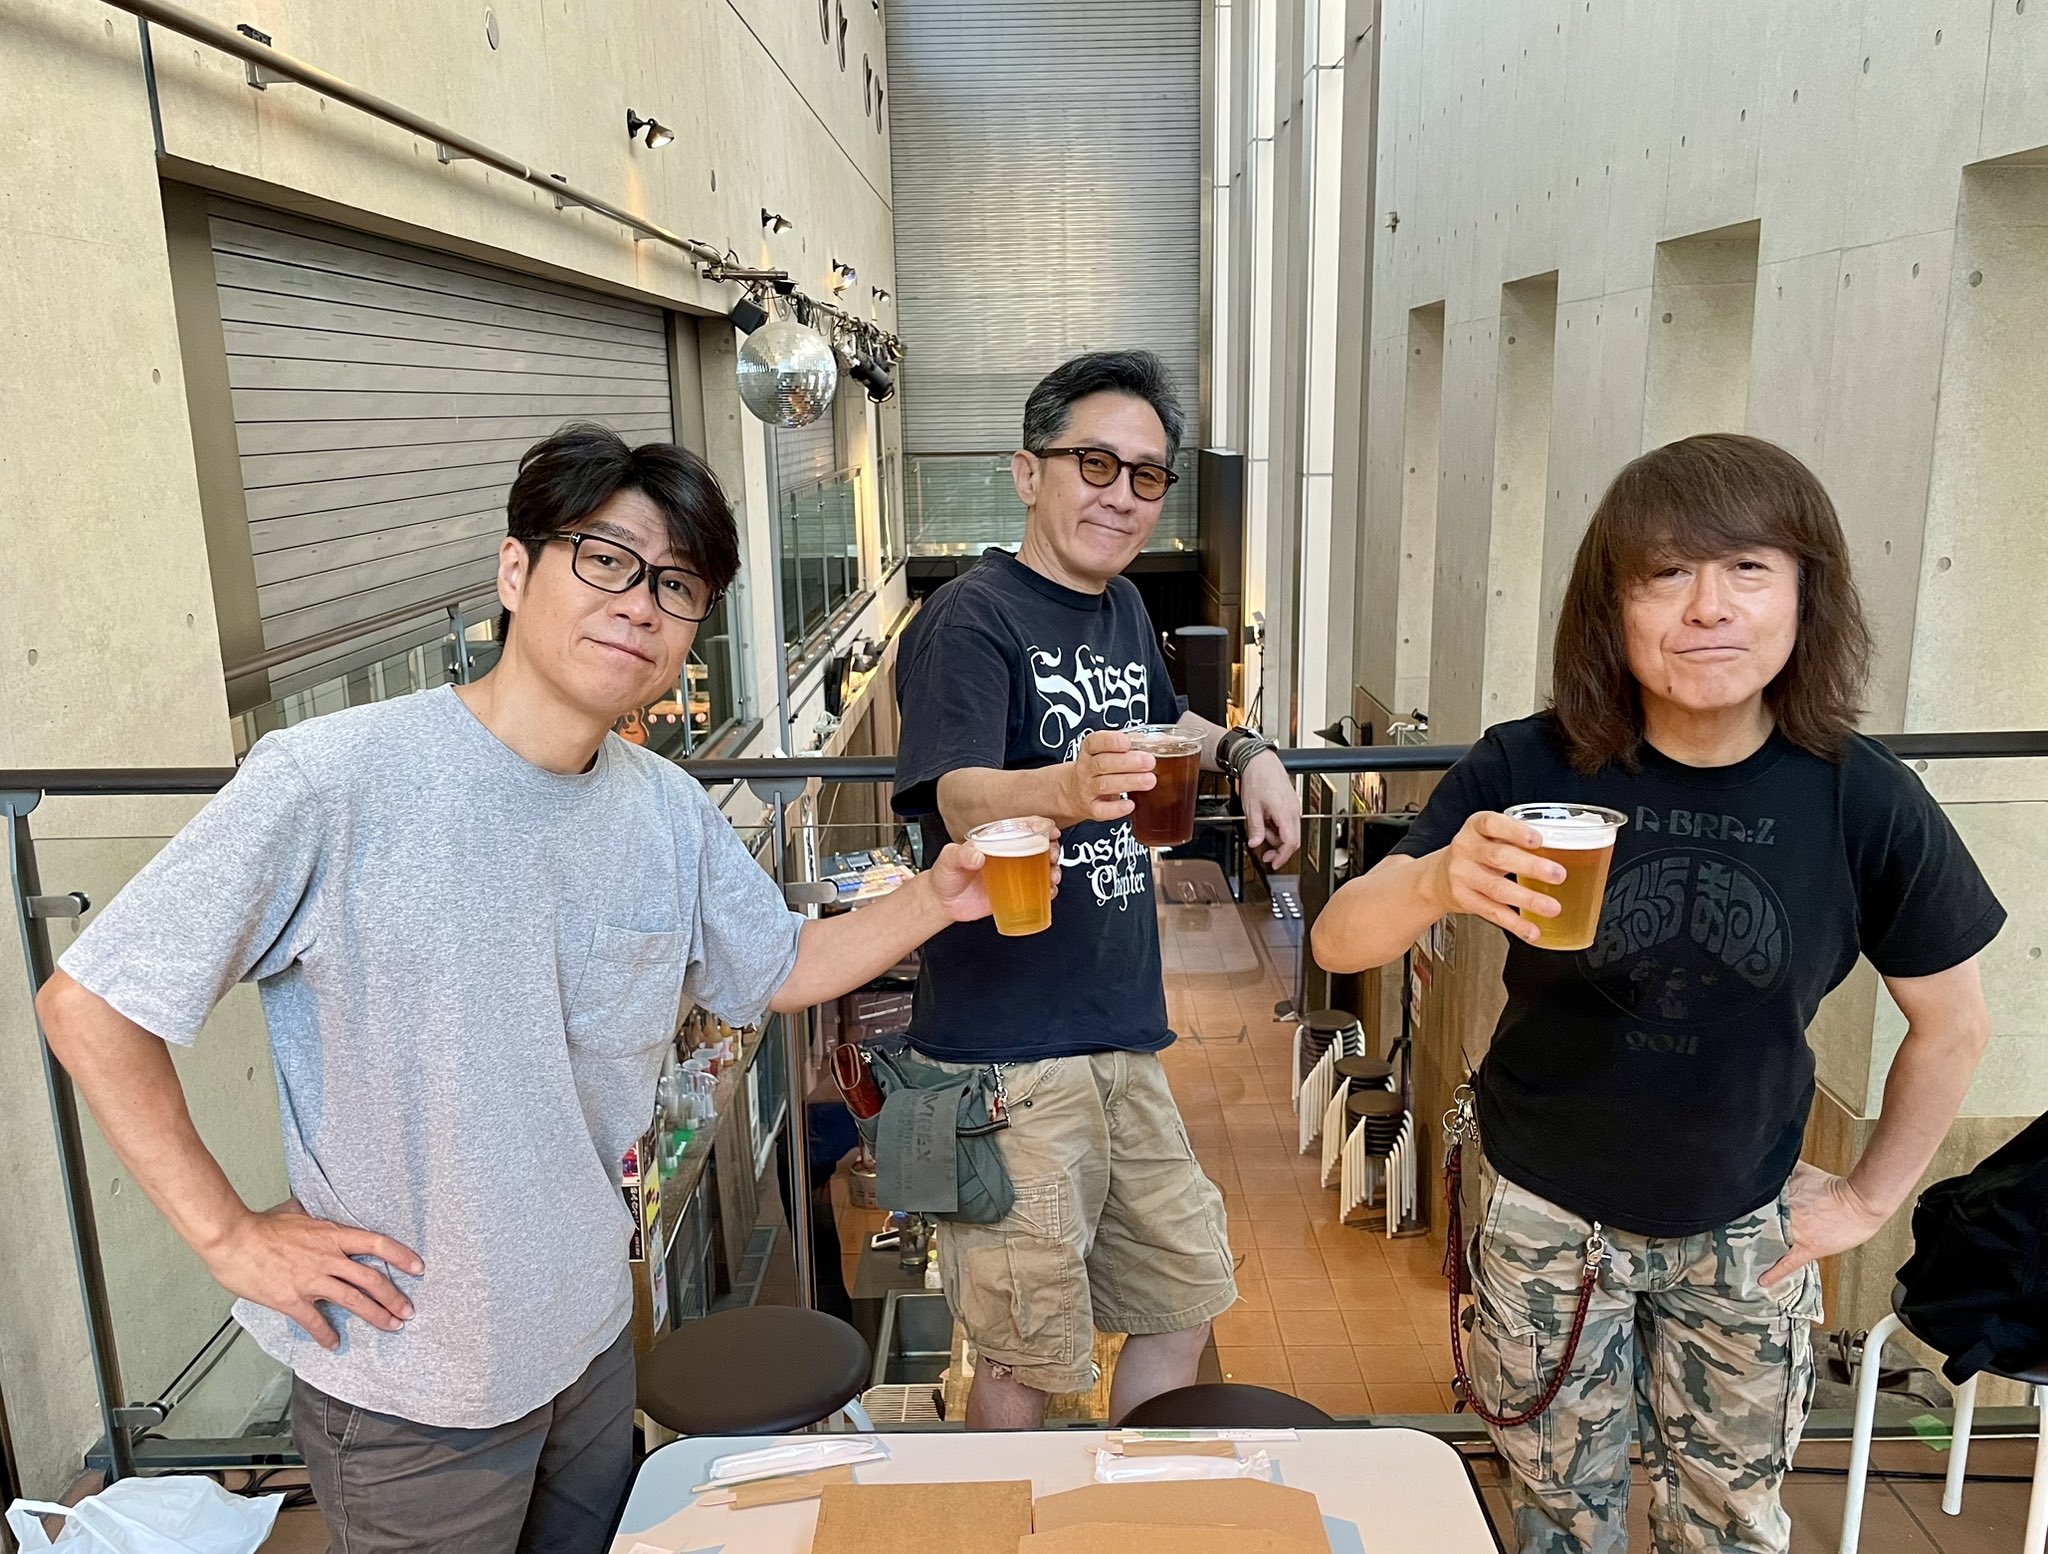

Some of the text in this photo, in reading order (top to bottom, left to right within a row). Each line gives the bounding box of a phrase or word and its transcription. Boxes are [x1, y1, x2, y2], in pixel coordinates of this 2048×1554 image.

[1027, 645, 1149, 748] Stüss
[1058, 839, 1114, 869] Los
[1086, 865, 1146, 911] Chapter
